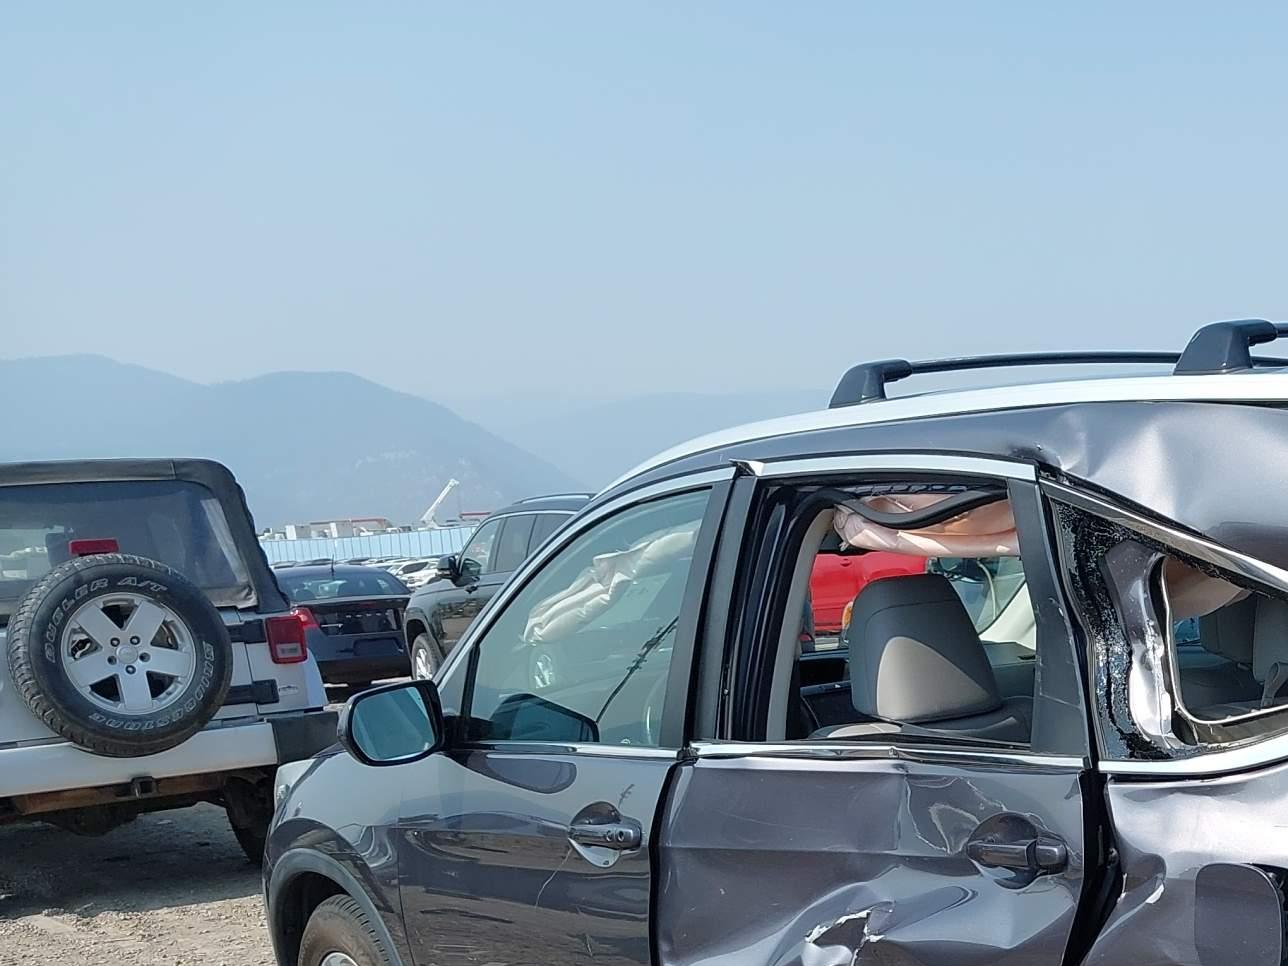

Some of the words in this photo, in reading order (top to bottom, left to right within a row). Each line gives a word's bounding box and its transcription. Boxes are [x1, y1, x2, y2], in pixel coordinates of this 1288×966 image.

[45, 577, 109, 663] DUELER
[117, 576, 168, 592] A/T
[88, 640, 215, 731] BRIDGESTONE
